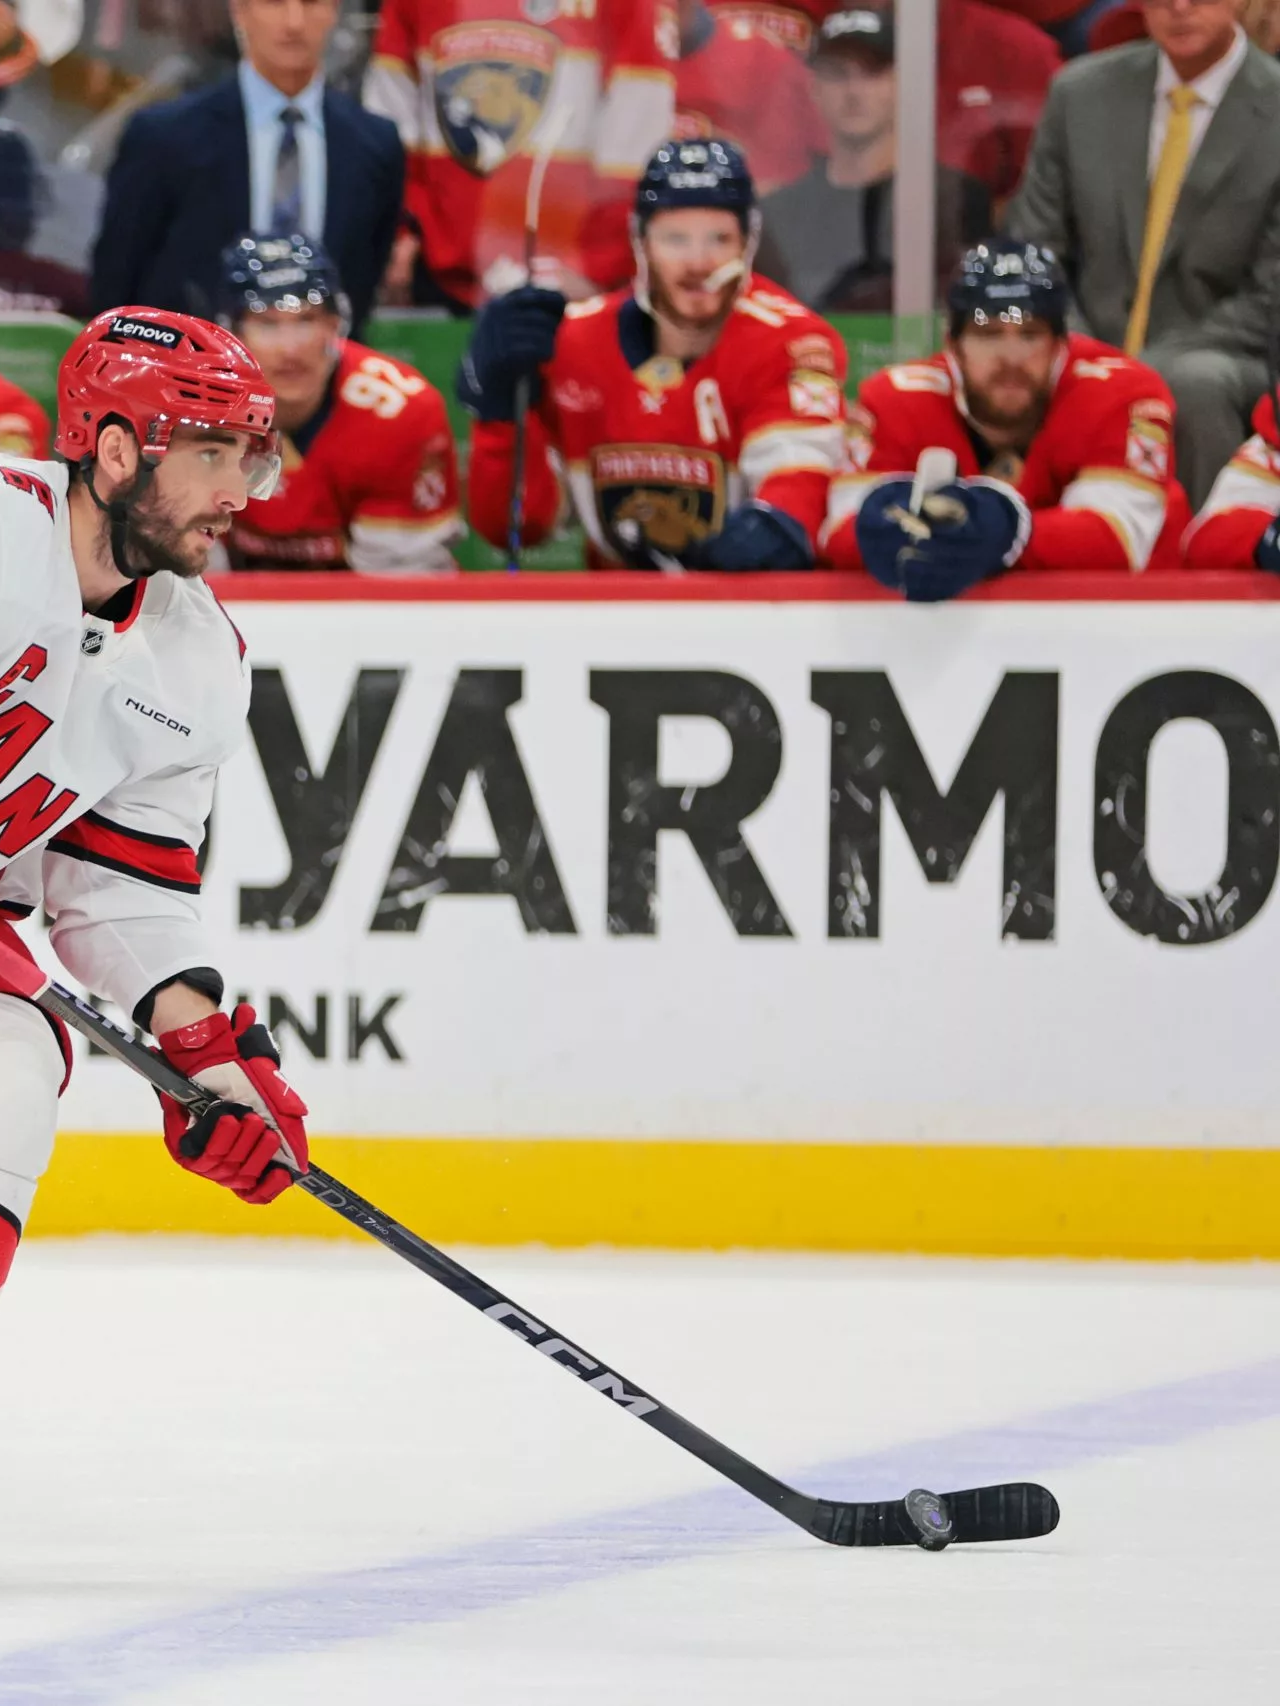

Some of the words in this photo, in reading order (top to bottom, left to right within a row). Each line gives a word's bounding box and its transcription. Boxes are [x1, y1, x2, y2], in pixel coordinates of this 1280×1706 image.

[113, 318, 176, 345] Lenovo
[342, 357, 424, 420] 92
[694, 378, 730, 444] A
[125, 697, 192, 737] NUCOR
[483, 1302, 660, 1417] CCM
